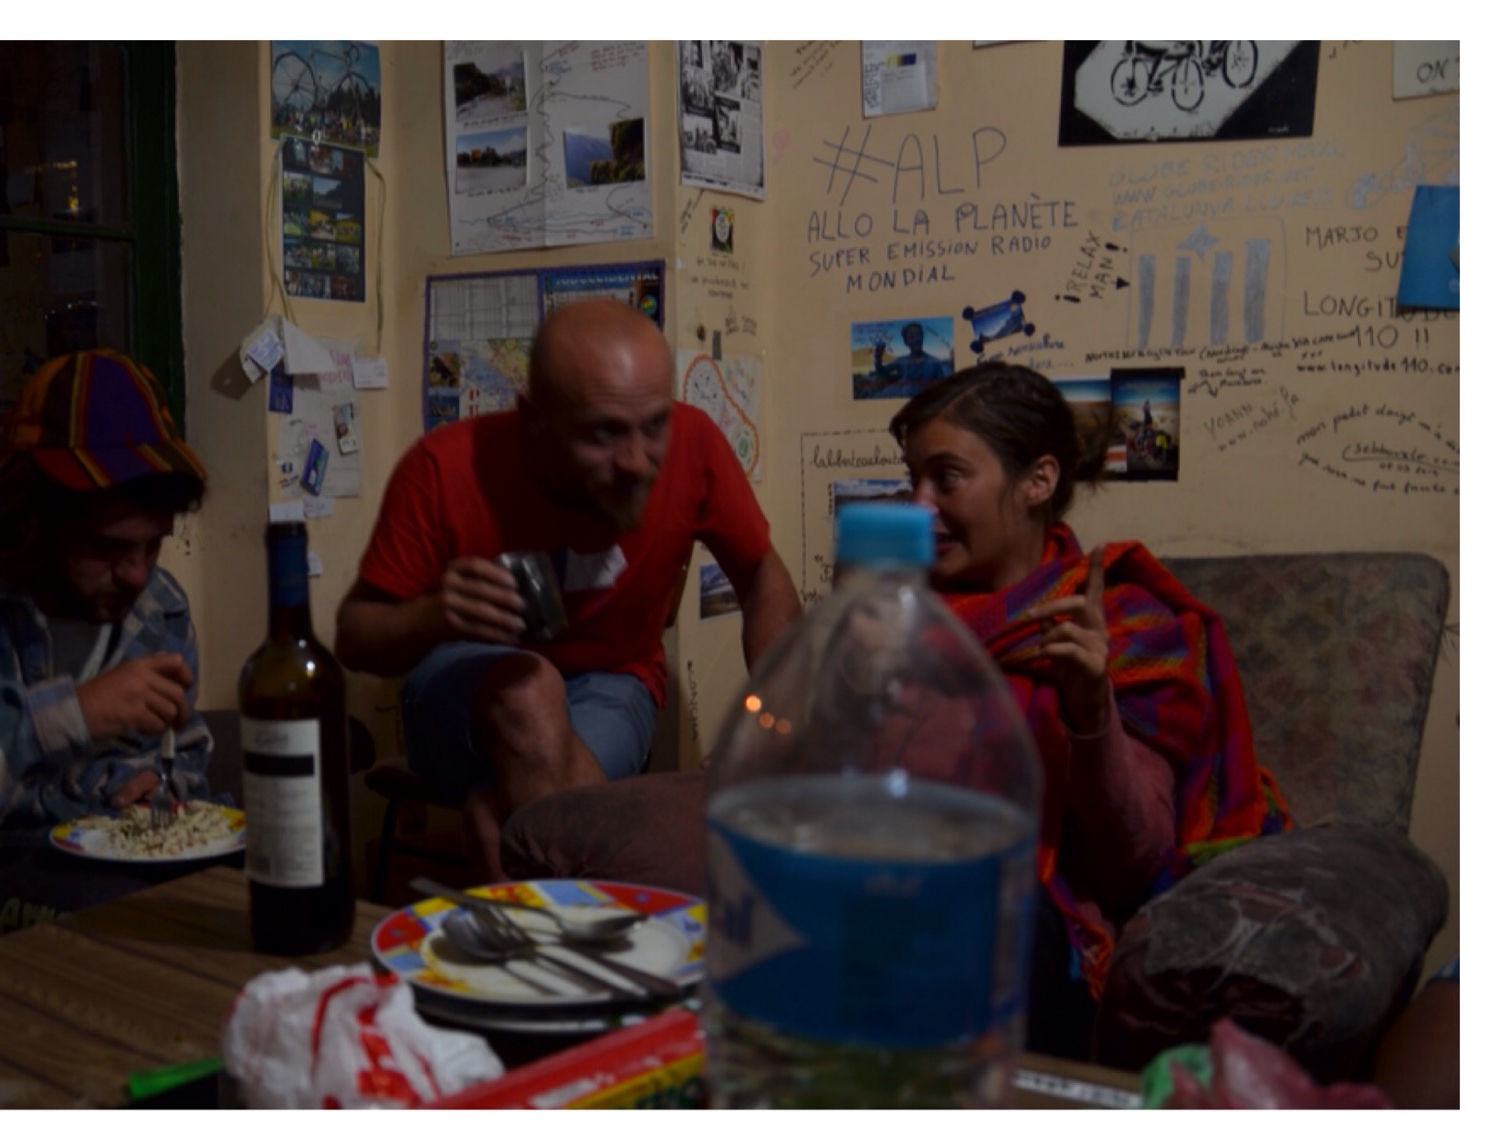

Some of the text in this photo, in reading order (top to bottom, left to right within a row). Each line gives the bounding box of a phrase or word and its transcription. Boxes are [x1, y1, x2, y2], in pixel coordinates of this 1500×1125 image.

[812, 123, 1008, 208] #ALP
[806, 191, 1079, 244] ALLO LA PLANÈTE
[808, 234, 1052, 278] SUPER EMISSION RADIO
[845, 264, 957, 294] MONDIAL
